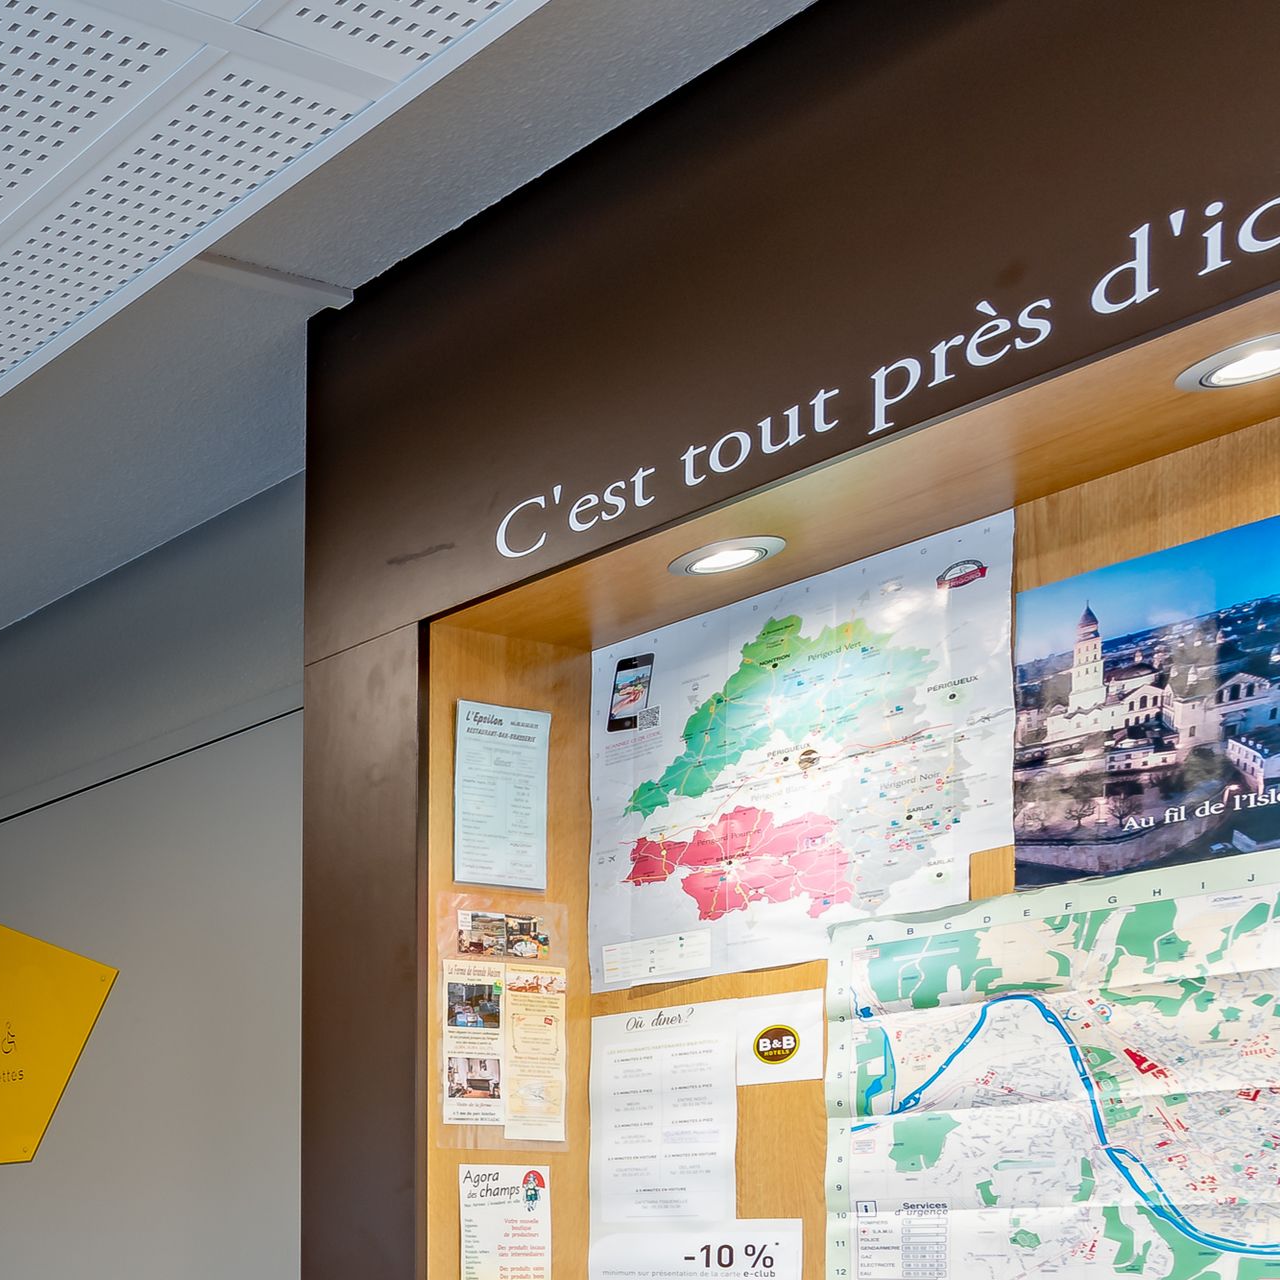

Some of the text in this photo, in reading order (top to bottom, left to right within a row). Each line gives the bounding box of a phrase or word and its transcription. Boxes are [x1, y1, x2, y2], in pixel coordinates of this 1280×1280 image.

[494, 465, 655, 561] C'est
[680, 388, 840, 489] tout
[868, 298, 1052, 435] près
[466, 710, 503, 726] L'Epsilon
[1122, 815, 1154, 832] Au
[1163, 804, 1186, 822] fil
[1195, 801, 1224, 818] de
[651, 1010, 682, 1029] dîner
[759, 1036, 795, 1052] B&B
[764, 1049, 790, 1057] HOTELS
[463, 1170, 499, 1188] Agora
[467, 1184, 520, 1199] des champs
[684, 1244, 734, 1268] -10
